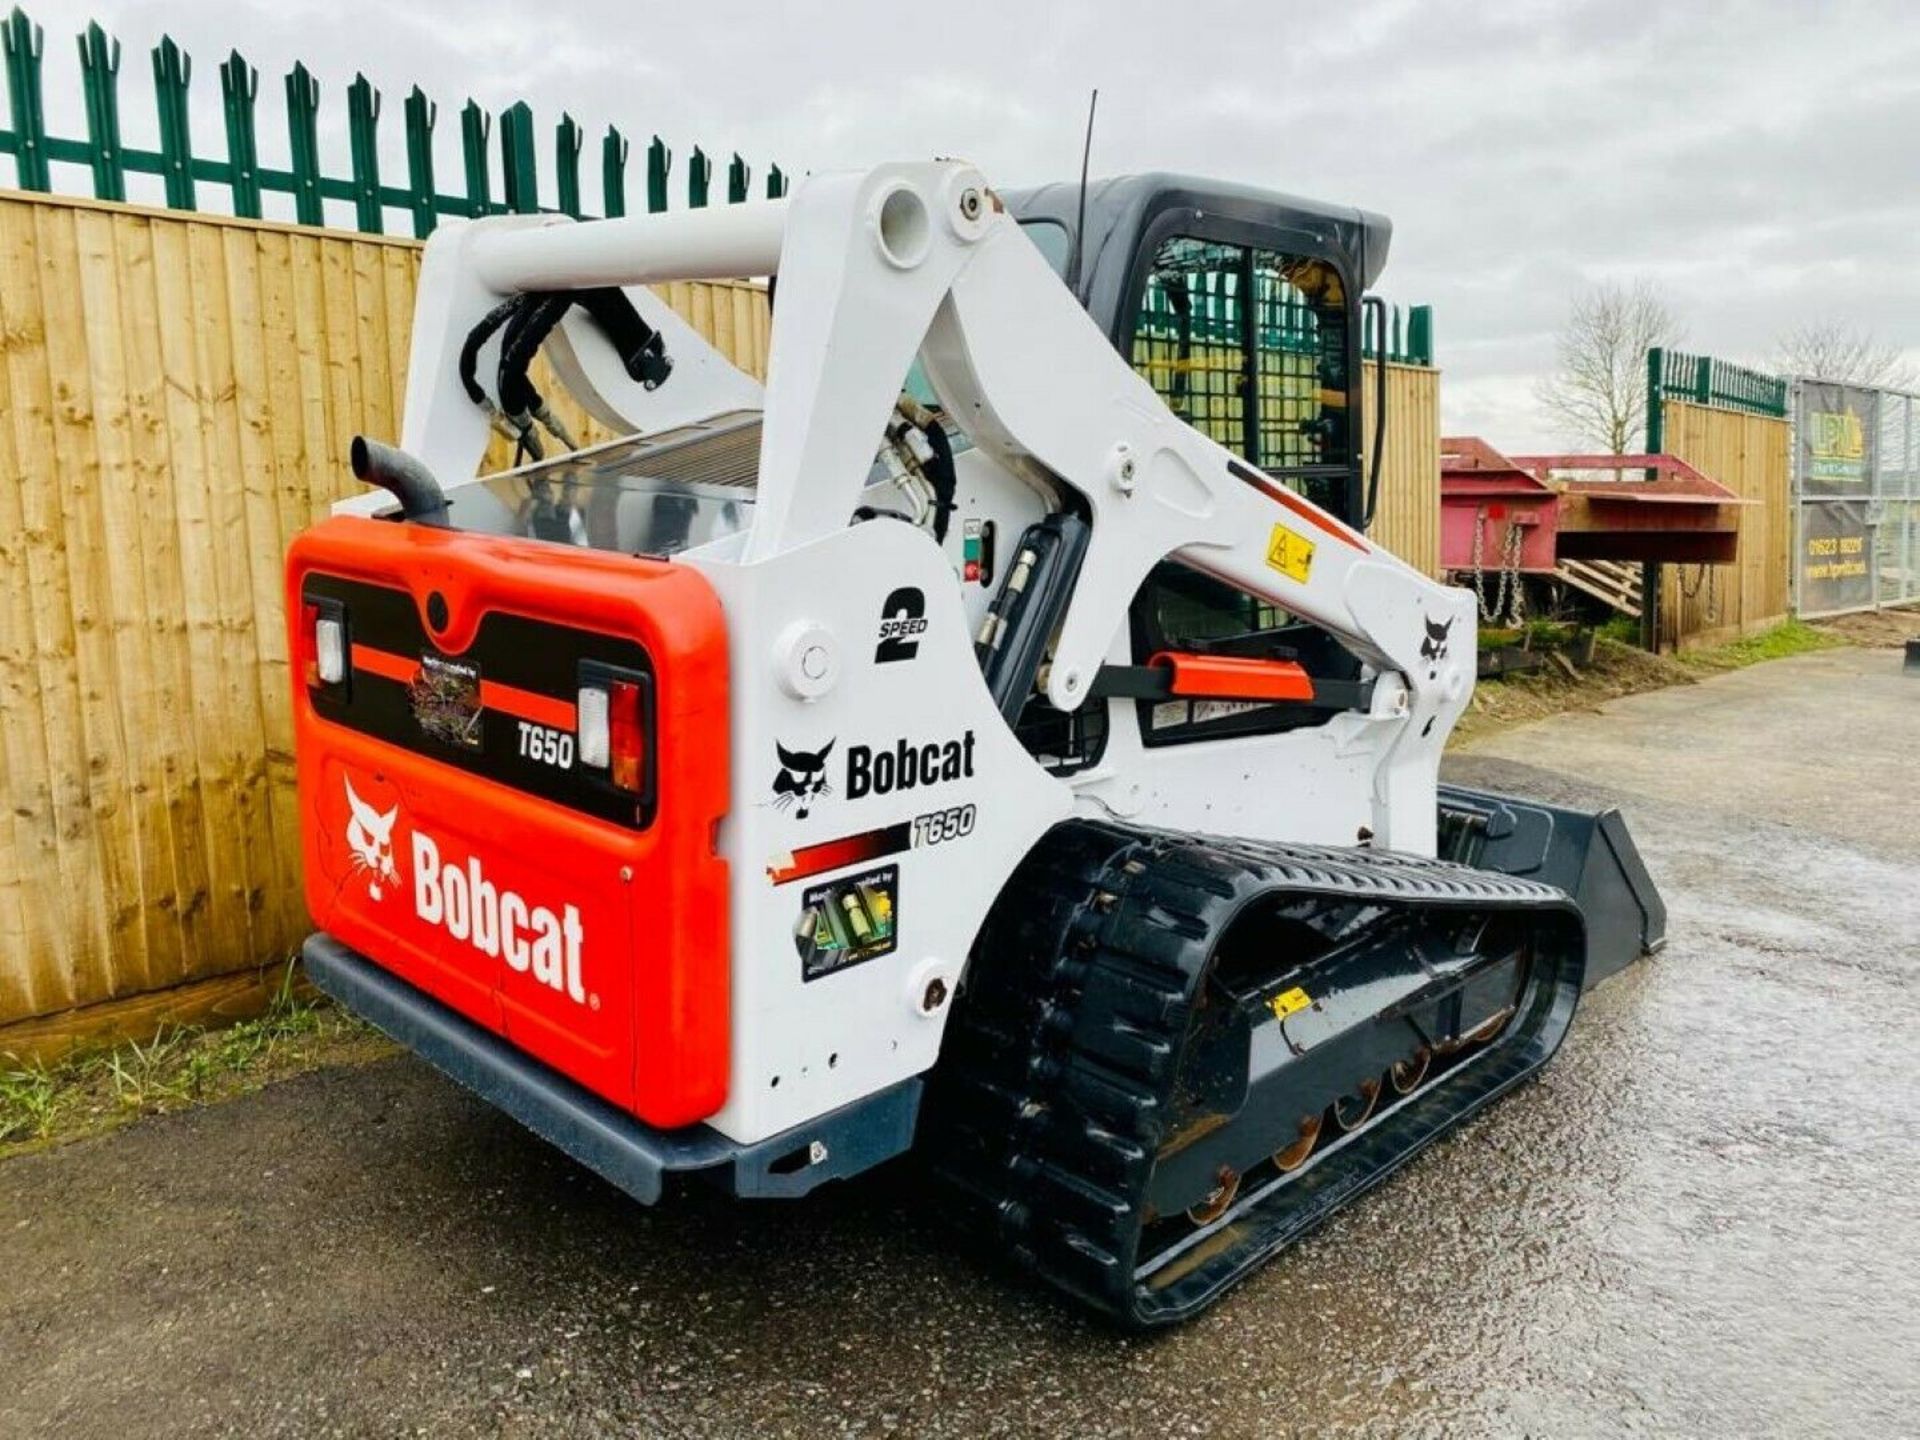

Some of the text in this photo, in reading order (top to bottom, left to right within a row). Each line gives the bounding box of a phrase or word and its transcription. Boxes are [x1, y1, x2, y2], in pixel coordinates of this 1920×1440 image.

[874, 586, 925, 664] 2
[878, 619, 928, 638] SPEED
[518, 720, 574, 769] T650
[846, 729, 975, 801] Bobcat
[914, 803, 977, 848] T650
[411, 829, 587, 1005] Bobcat
